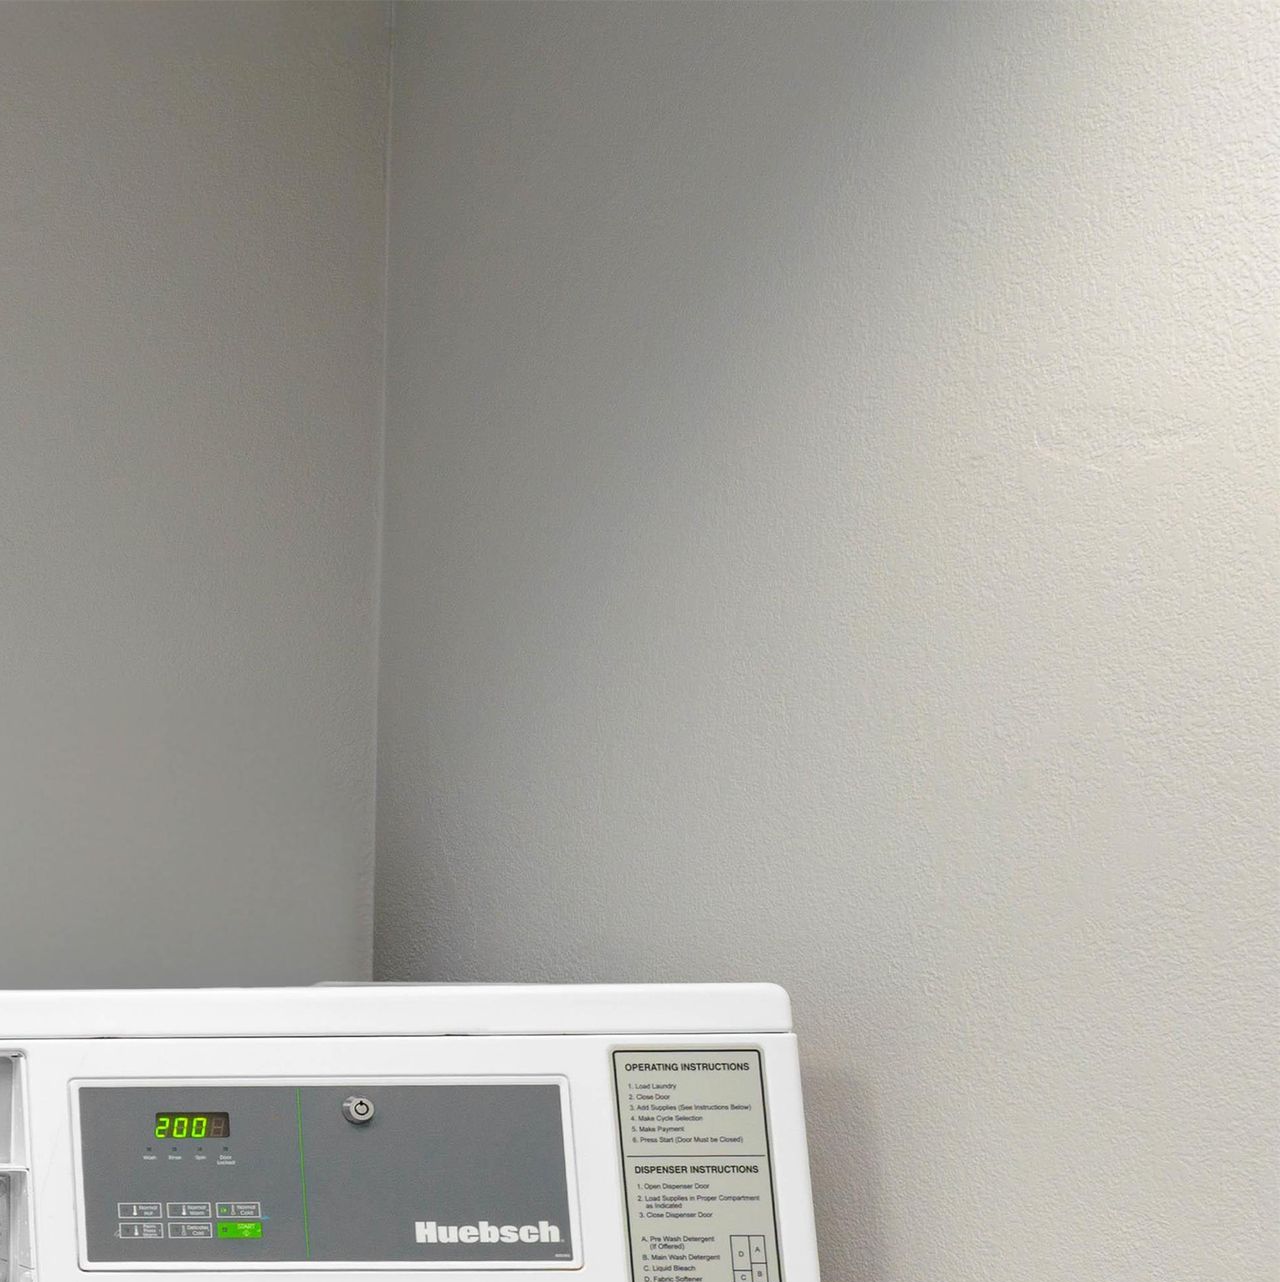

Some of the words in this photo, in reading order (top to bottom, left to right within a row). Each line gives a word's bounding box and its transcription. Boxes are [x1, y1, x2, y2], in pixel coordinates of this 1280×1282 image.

[625, 1063, 678, 1072] OPERATING
[681, 1062, 750, 1071] INSTRUCTIONS
[652, 1083, 677, 1091] Laundry
[678, 1104, 693, 1112] (See
[730, 1104, 751, 1112] Below)
[656, 1115, 673, 1123] Cycle
[154, 1117, 207, 1138] 200
[657, 1126, 684, 1134] Payment
[675, 1136, 692, 1144] (Door
[720, 1136, 743, 1144] Closed)
[635, 1166, 688, 1174] DISPENSER
[690, 1165, 759, 1174] INSTRUCTIONS
[644, 1183, 661, 1191] Open
[662, 1183, 693, 1191] Dispenser
[662, 1195, 688, 1203] Supplies
[697, 1195, 717, 1203] Proper
[718, 1195, 760, 1203] Compartment
[666, 1212, 696, 1220] Dispenser
[415, 1220, 560, 1243] Huebsch
[683, 1236, 715, 1244] Detergent
[658, 1243, 685, 1251] Offered)
[688, 1254, 720, 1262] Detergent
[652, 1265, 672, 1273] Liquid
